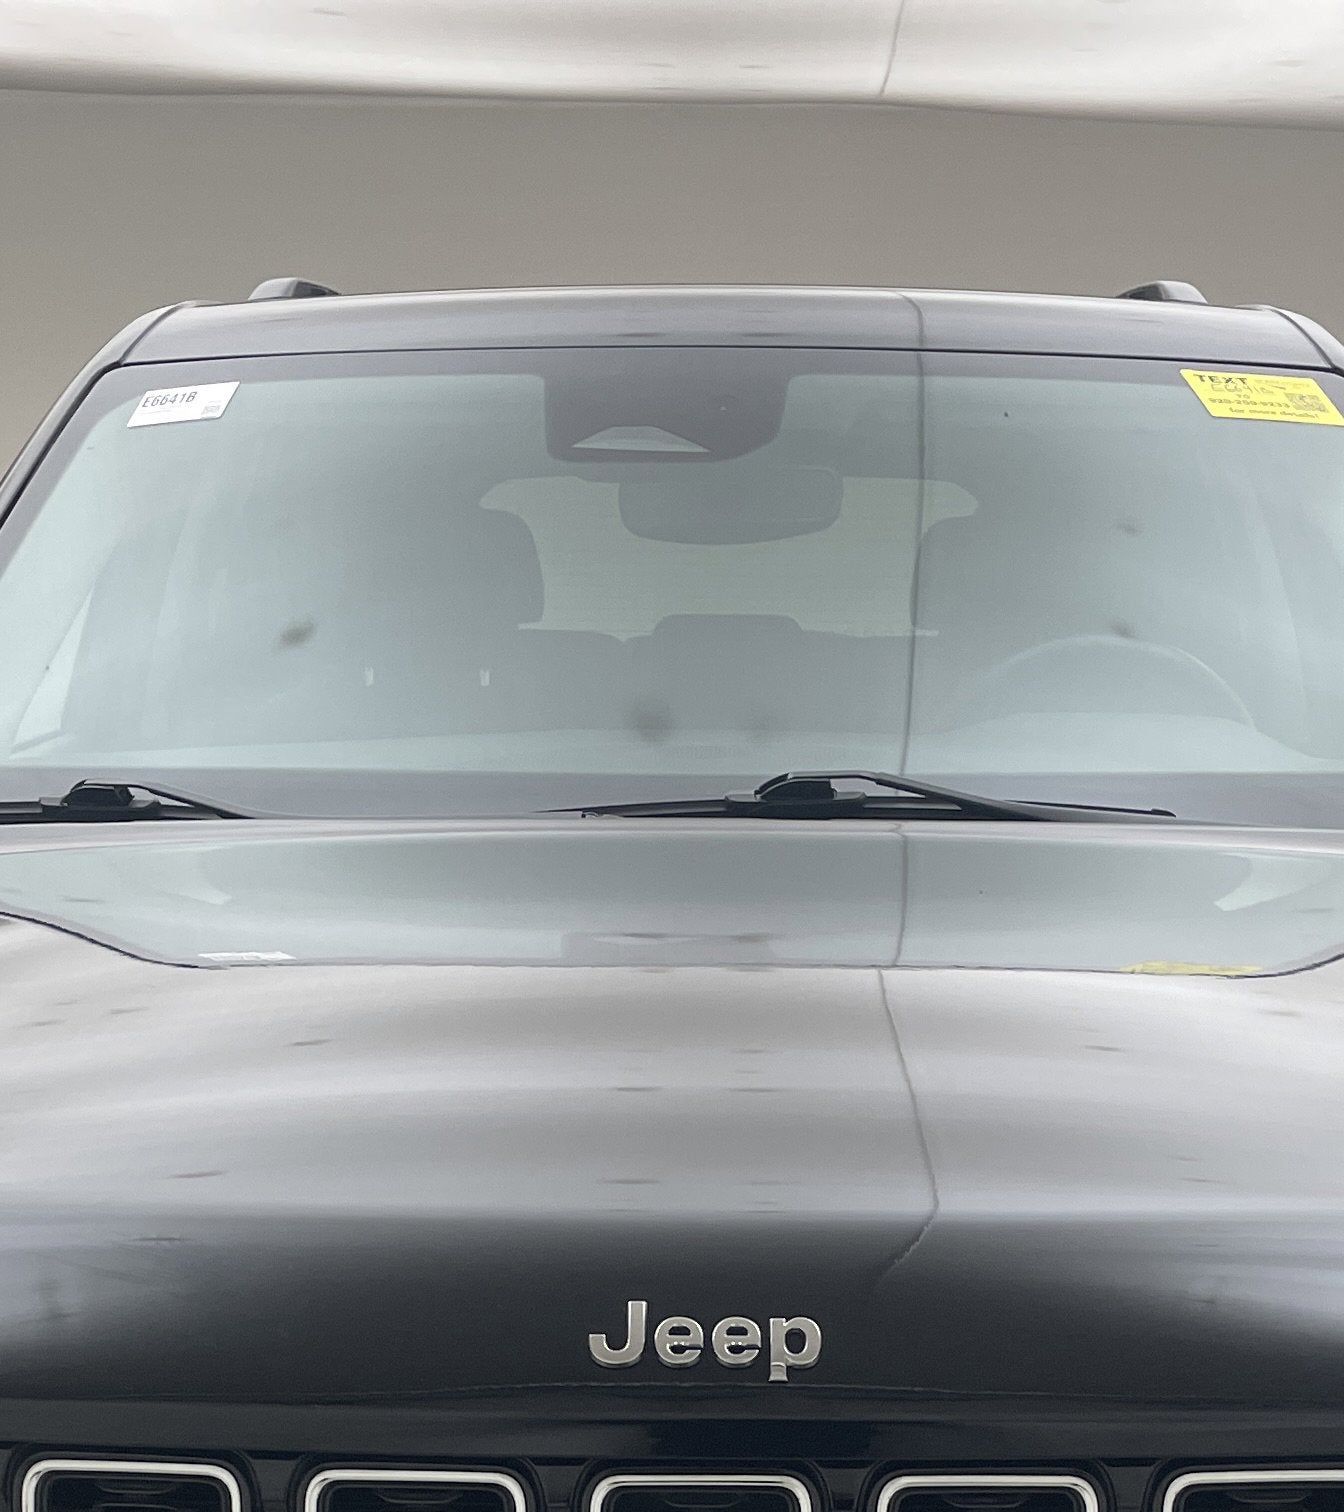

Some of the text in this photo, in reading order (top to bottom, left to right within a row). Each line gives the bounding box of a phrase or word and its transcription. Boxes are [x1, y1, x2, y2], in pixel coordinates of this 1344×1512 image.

[1193, 373, 1248, 384] TEXT
[141, 391, 198, 408] E6641B
[588, 1299, 823, 1383] Jeep
